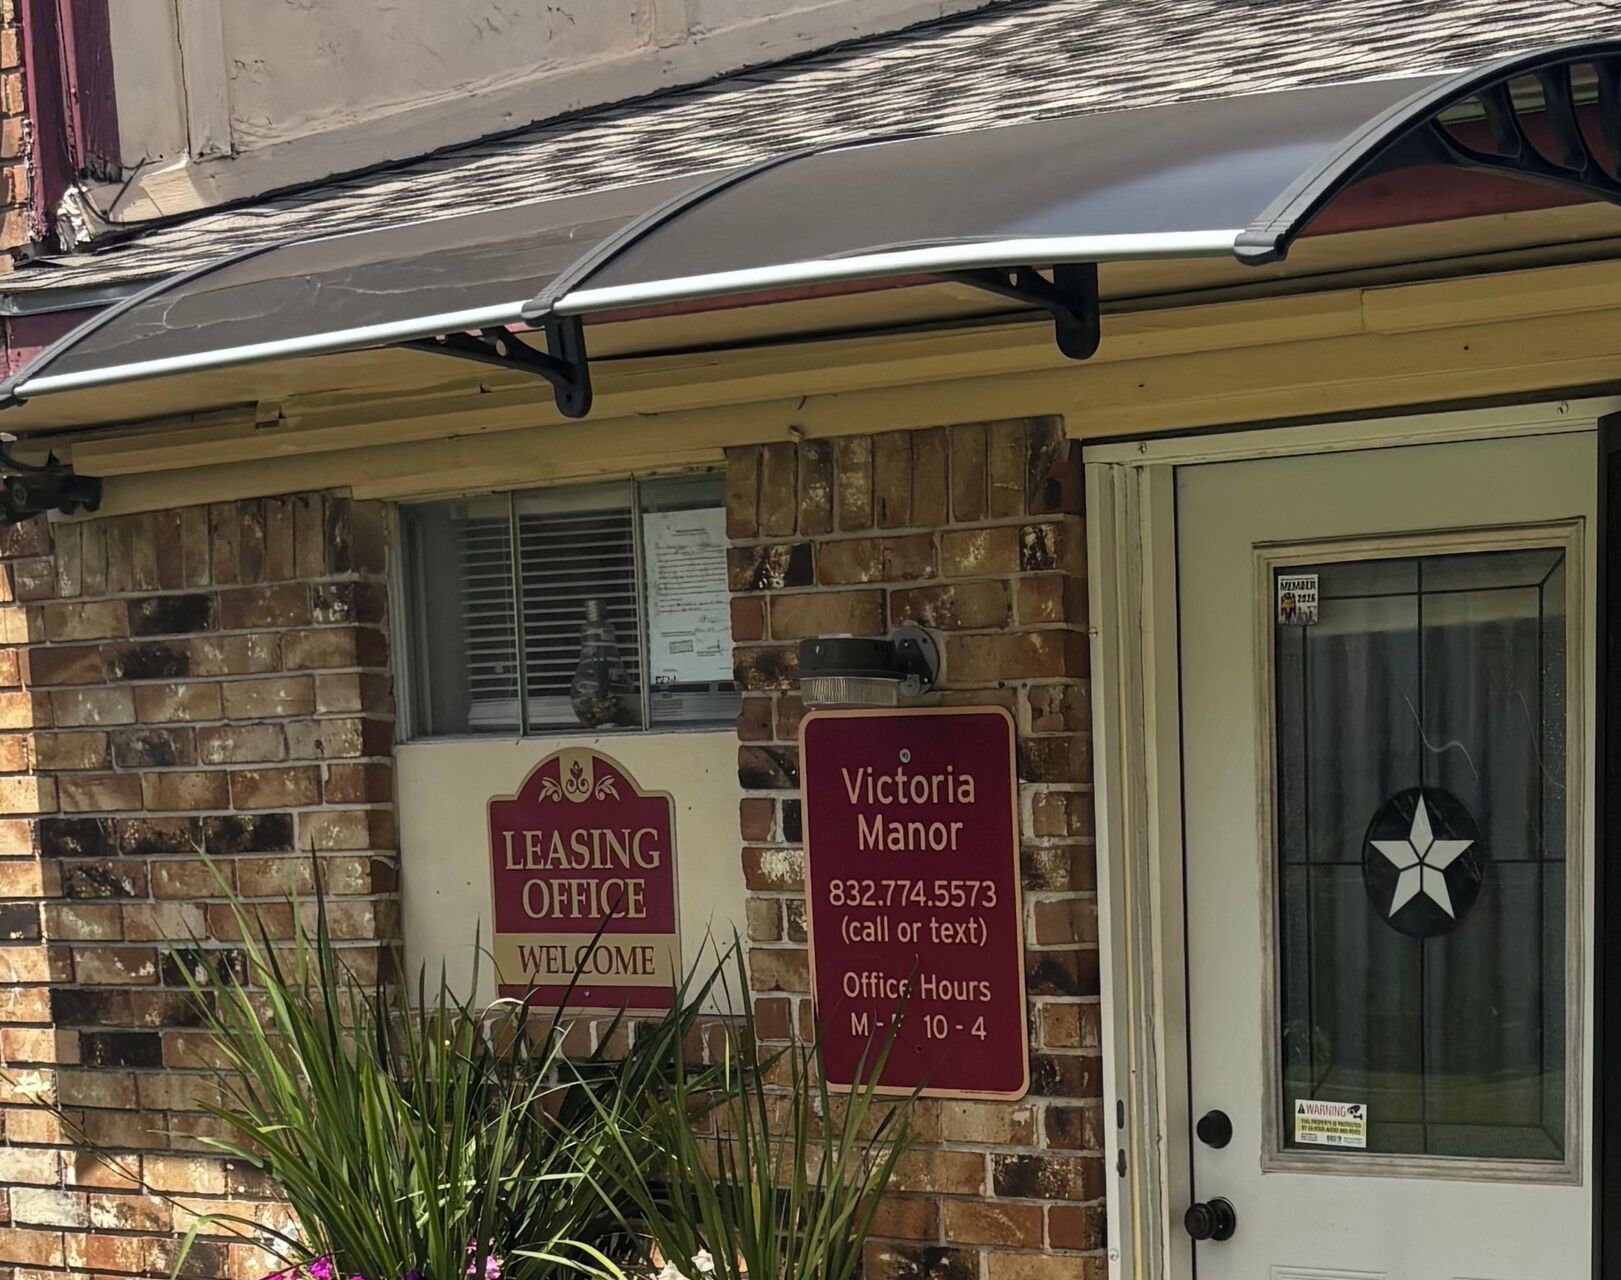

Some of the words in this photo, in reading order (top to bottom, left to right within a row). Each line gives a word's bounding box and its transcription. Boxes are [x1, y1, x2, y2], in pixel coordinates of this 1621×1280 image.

[1280, 581, 1316, 590] MEMBER
[841, 765, 975, 805] Victoria
[857, 814, 964, 851] Manor
[503, 828, 661, 870] LEASING
[522, 878, 647, 919] OFFICE
[829, 879, 997, 908] 832.774.5573
[841, 915, 889, 945] (call
[897, 921, 922, 942] or
[929, 917, 987, 947] text)
[518, 945, 655, 976] WELCOME
[843, 971, 912, 999] Office
[920, 973, 992, 1002] Hours
[850, 1012, 869, 1037] M
[923, 1014, 948, 1039] 10
[971, 1016, 987, 1040] 4
[1307, 1104, 1346, 1117] WARNING
